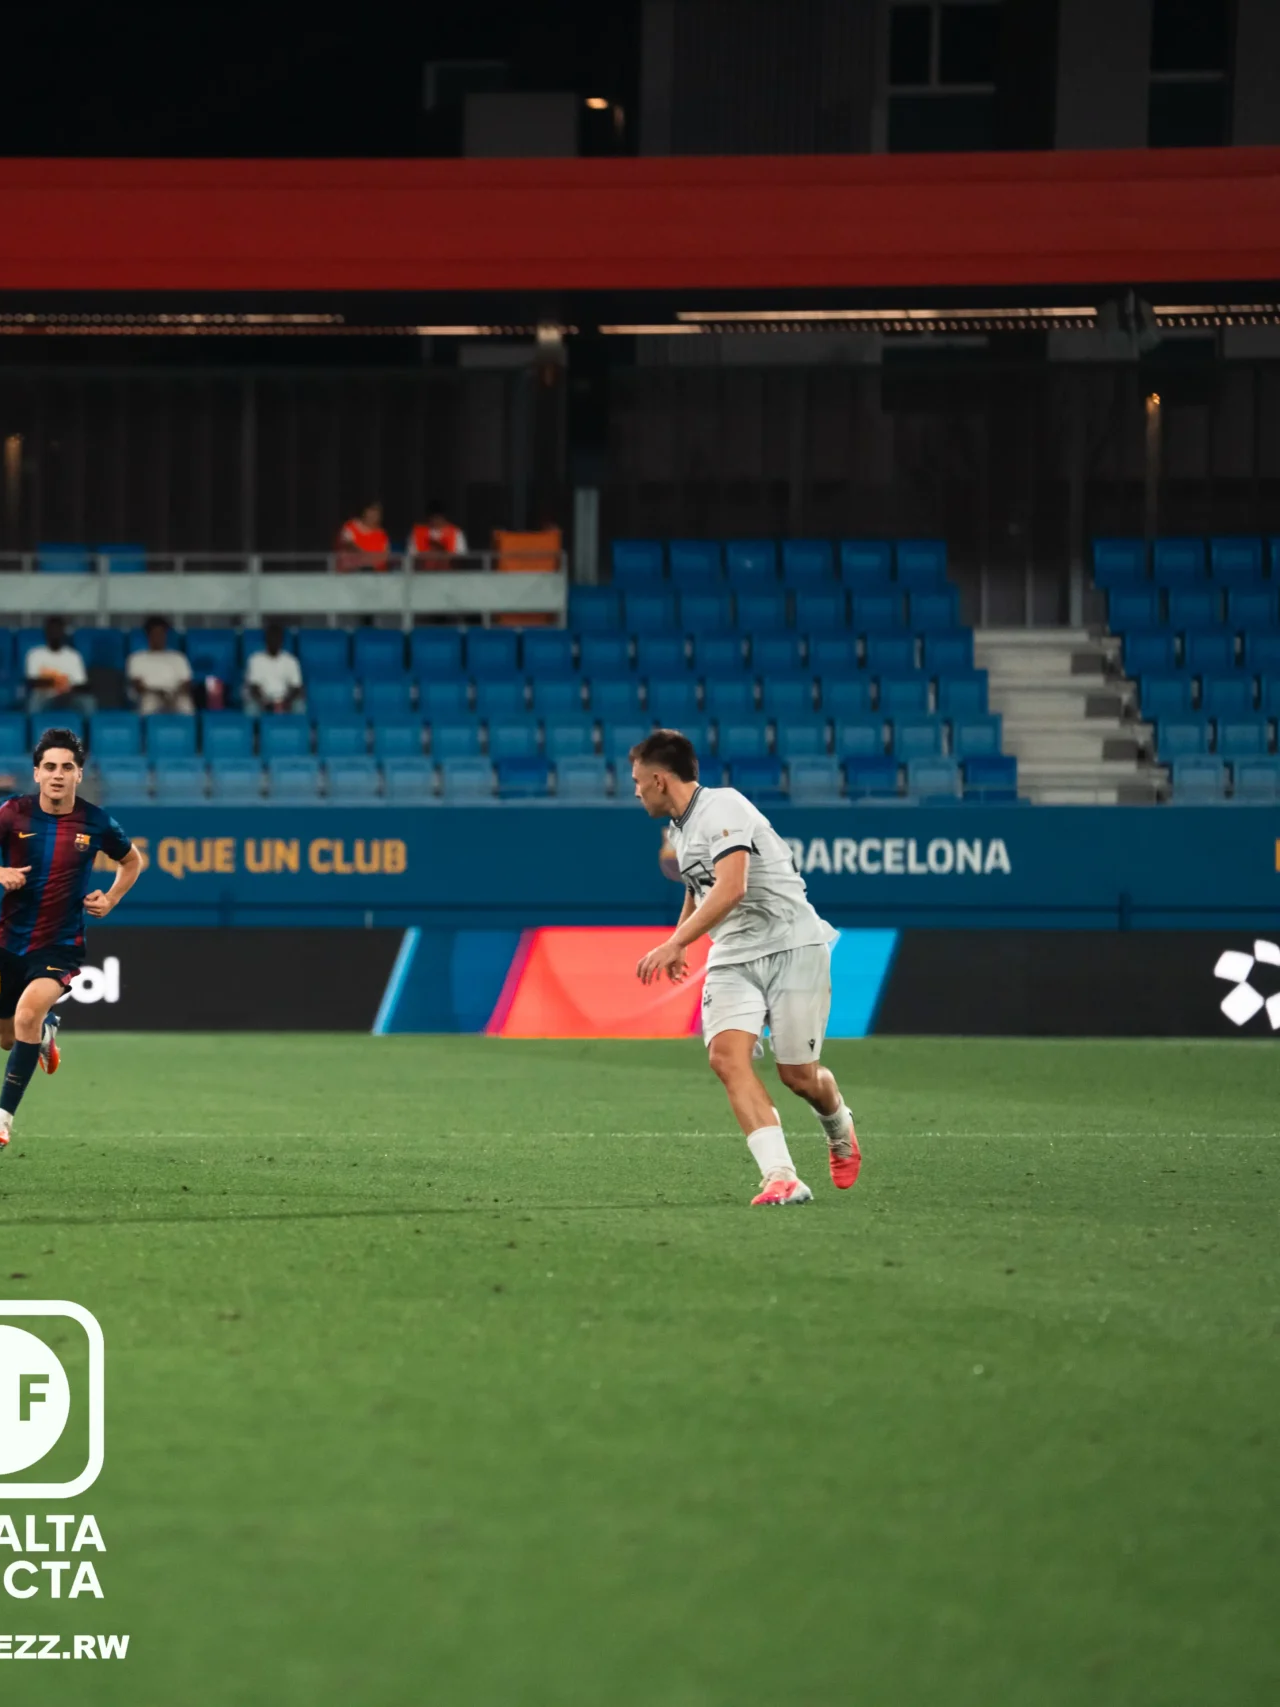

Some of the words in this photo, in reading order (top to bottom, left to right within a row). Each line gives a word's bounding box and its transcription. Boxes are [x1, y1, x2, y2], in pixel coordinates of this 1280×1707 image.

[157, 837, 235, 879] QUE
[244, 838, 299, 873] UN
[308, 838, 407, 874] CLUB
